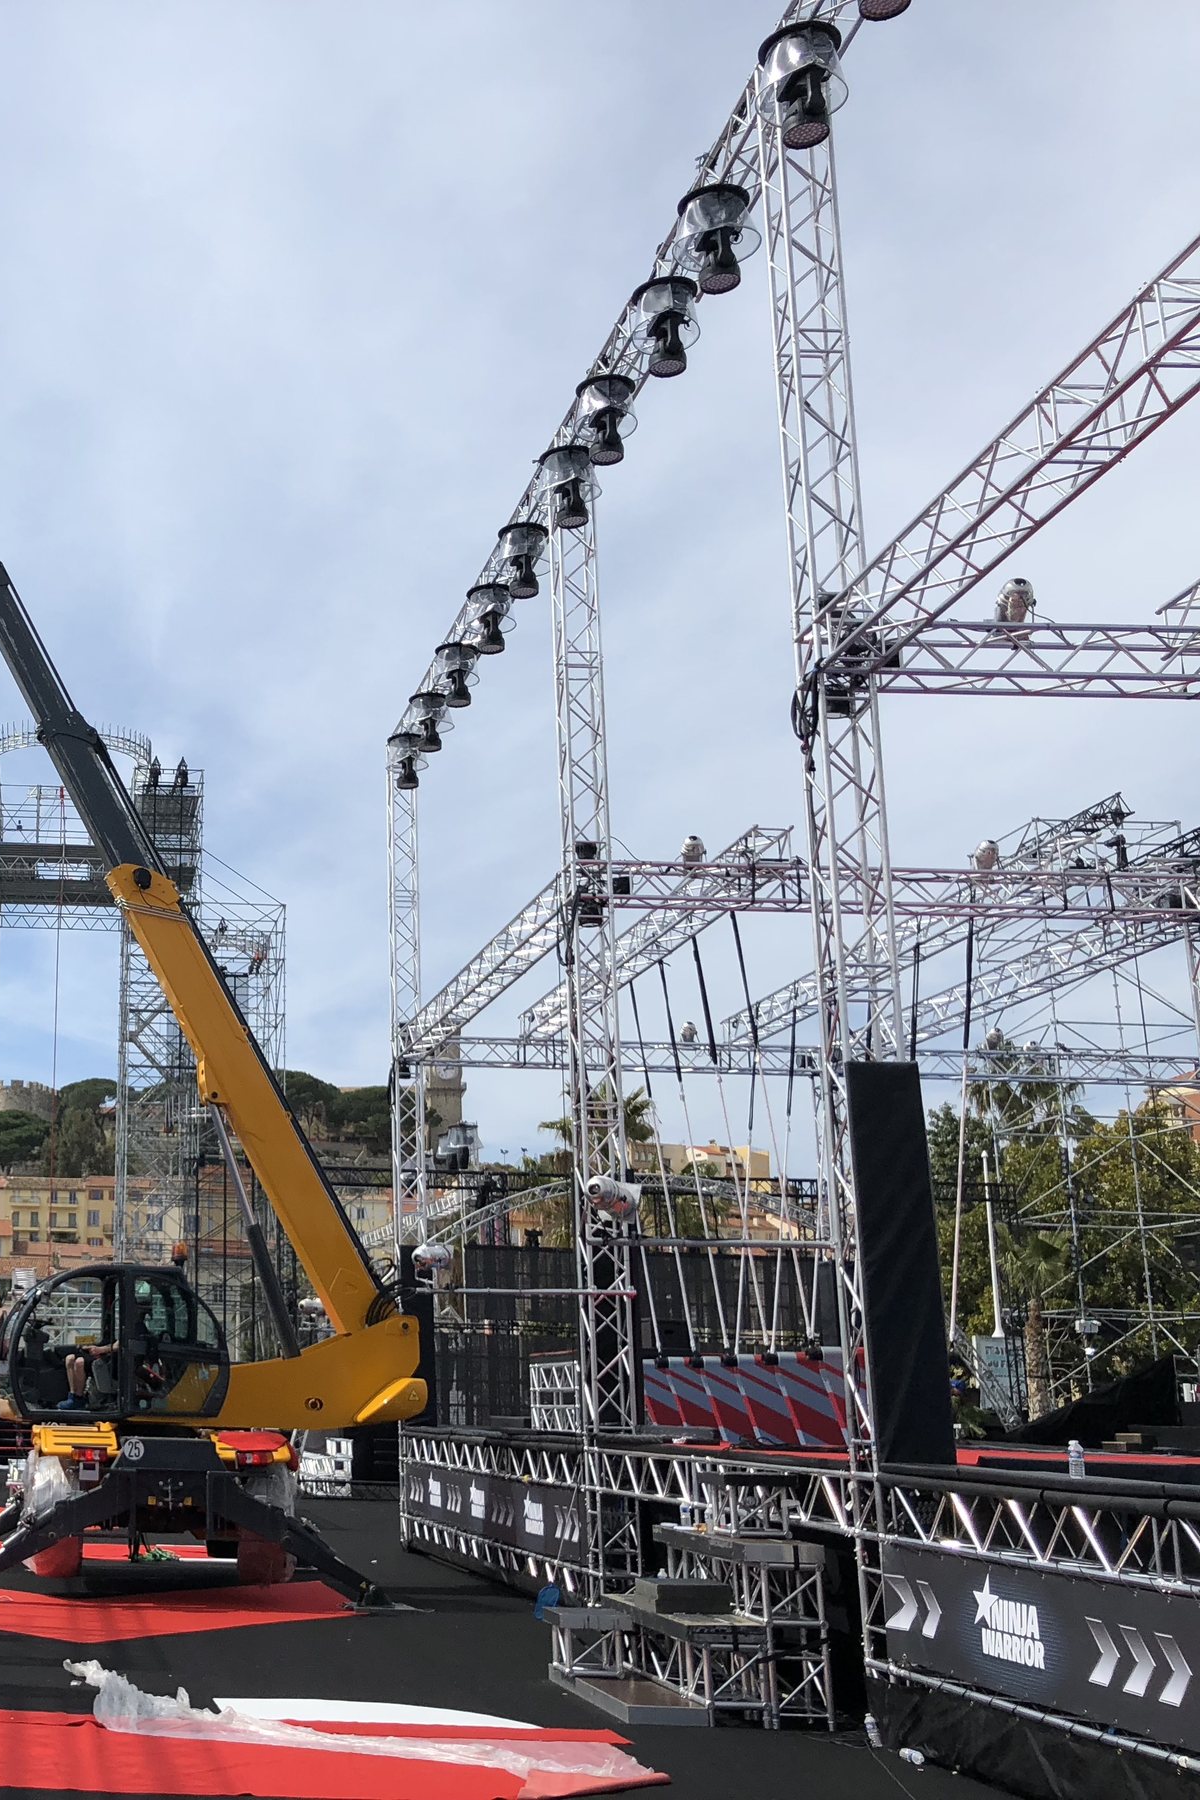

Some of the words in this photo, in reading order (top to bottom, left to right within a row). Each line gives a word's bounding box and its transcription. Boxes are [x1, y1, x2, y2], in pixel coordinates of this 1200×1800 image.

[127, 1440, 141, 1458] 25
[991, 1598, 1040, 1640] NINJA
[981, 1627, 1046, 1670] WARRIOR
